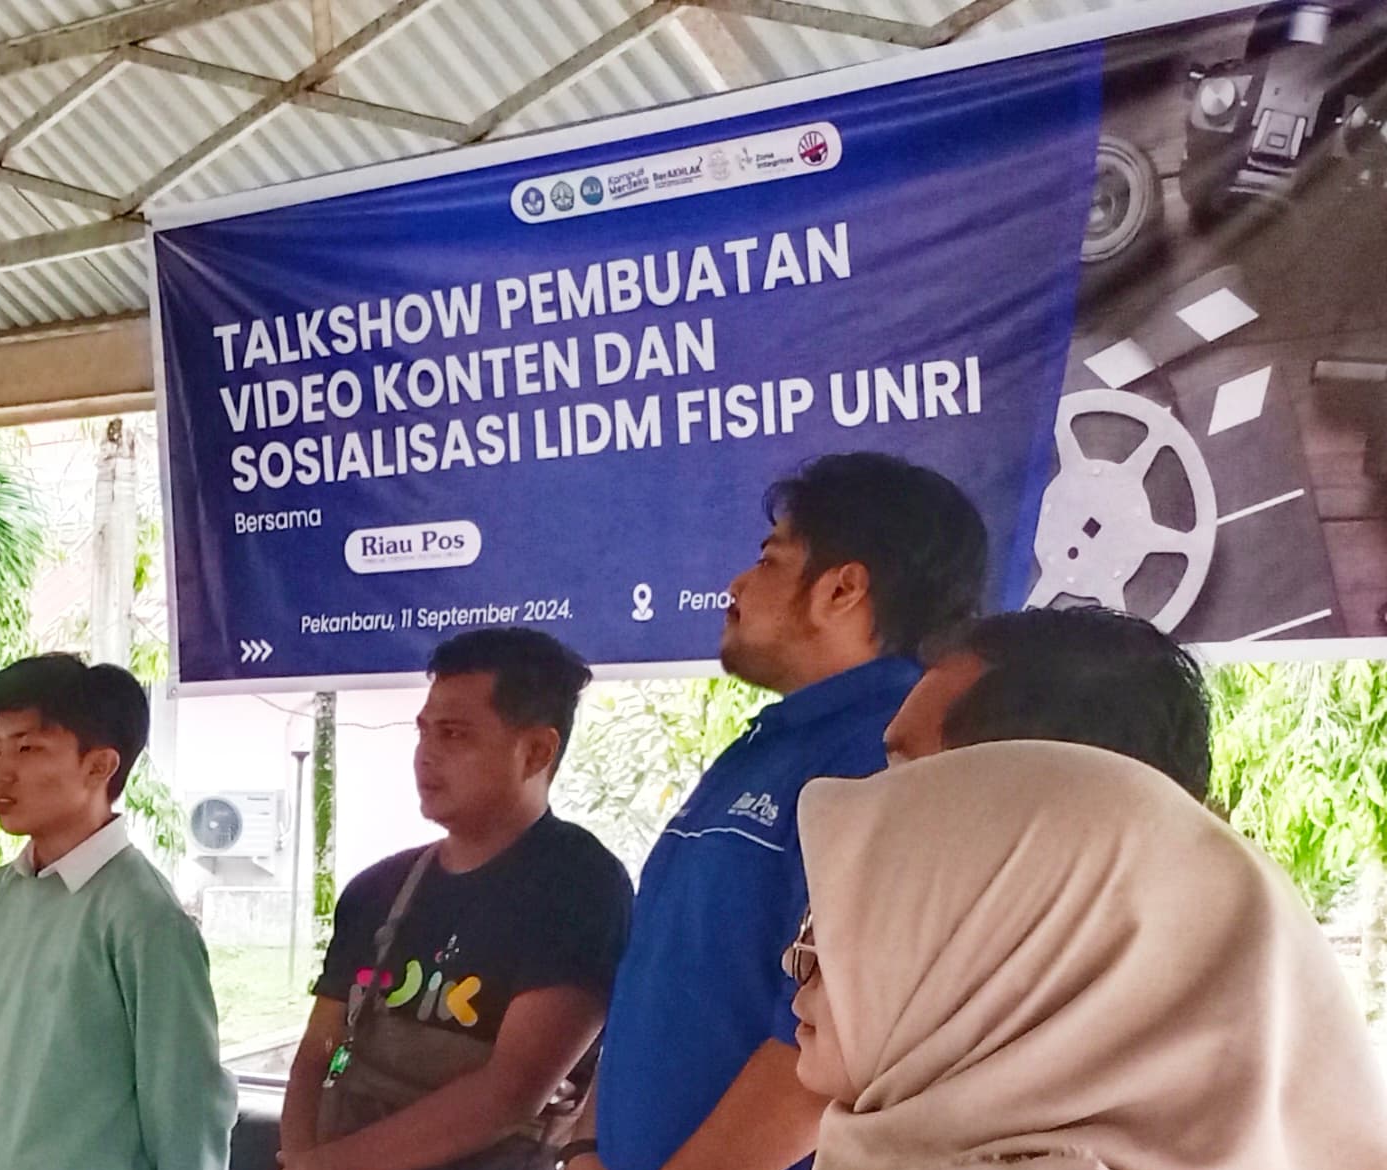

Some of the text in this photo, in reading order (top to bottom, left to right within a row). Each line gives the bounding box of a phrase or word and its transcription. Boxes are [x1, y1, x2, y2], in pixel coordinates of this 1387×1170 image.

[213, 222, 851, 372] TALKSHOW PEMBUATAN
[220, 318, 715, 433] VIDEO KONTEN DAN
[231, 356, 982, 492] SOSIALISASI LIDM FISIP UNRI
[234, 508, 322, 534] Bersama
[361, 531, 465, 556] Riau Pos
[300, 598, 573, 633] Pekanbaru, 11 September 2024.
